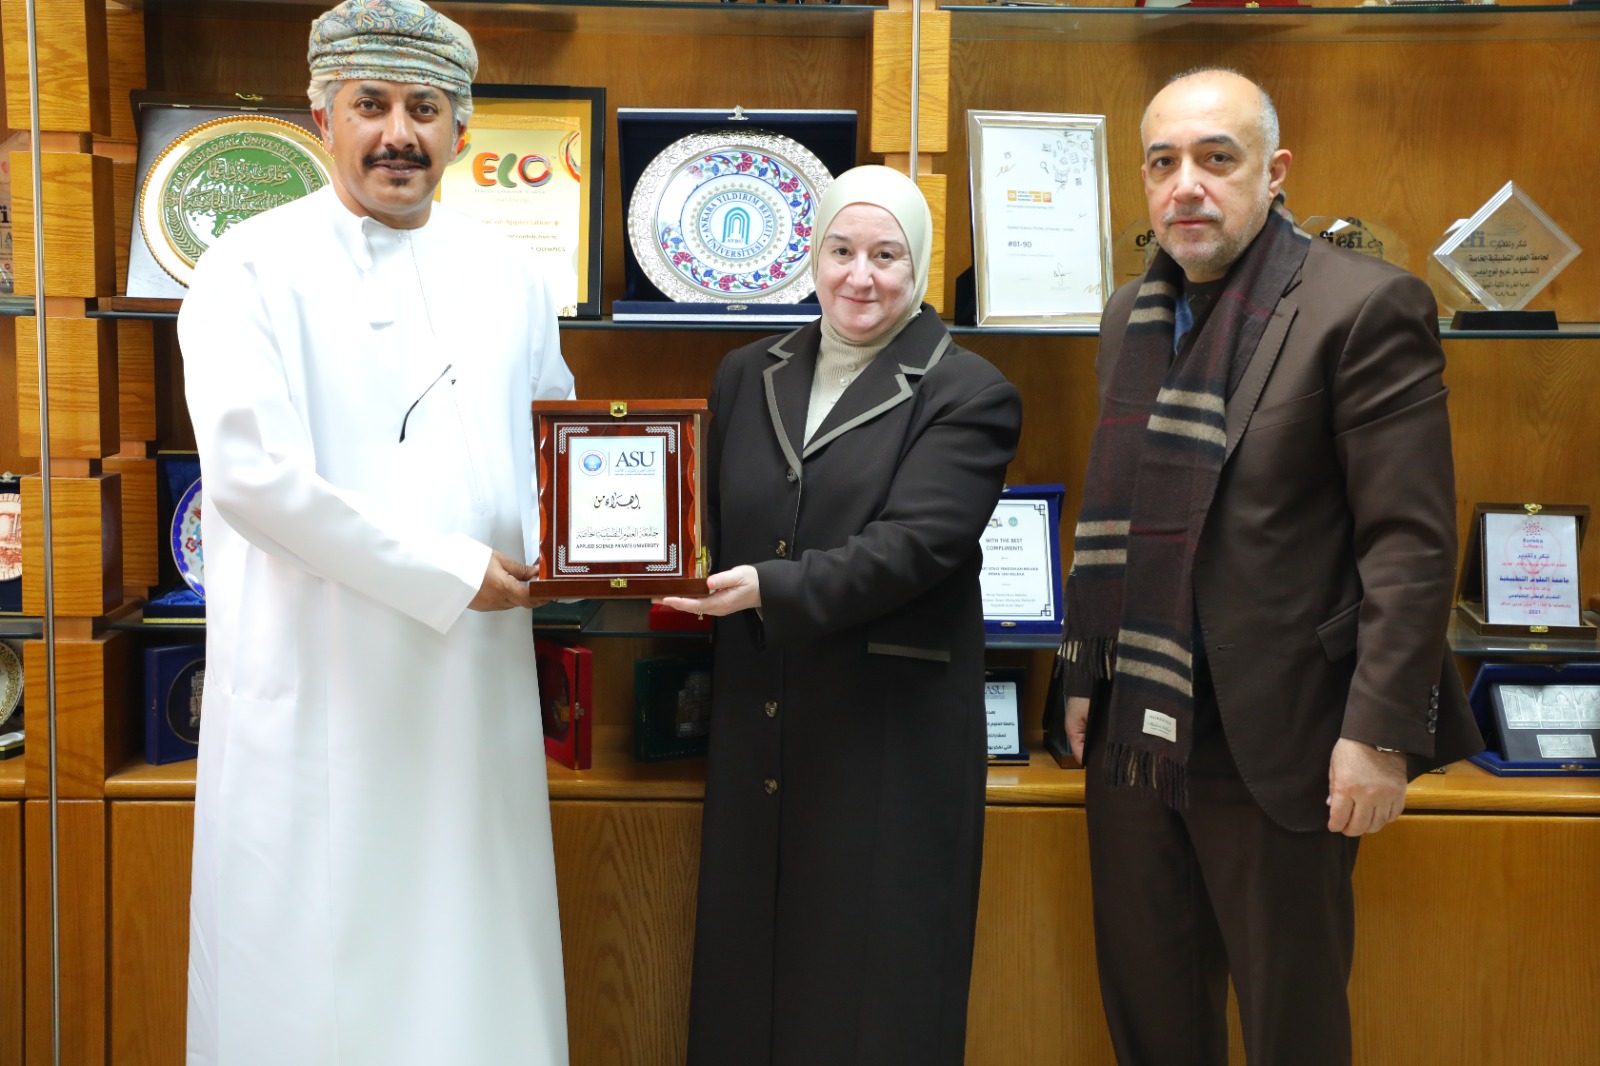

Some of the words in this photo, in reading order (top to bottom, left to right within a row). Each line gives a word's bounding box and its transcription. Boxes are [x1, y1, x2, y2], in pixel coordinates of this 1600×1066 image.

[243, 134, 300, 161] UNIVERSITY
[701, 203, 718, 233] ANKARA
[716, 192, 760, 206] YILDIRIM
[758, 203, 772, 238] BEYAZIT
[614, 450, 656, 468] ASU
